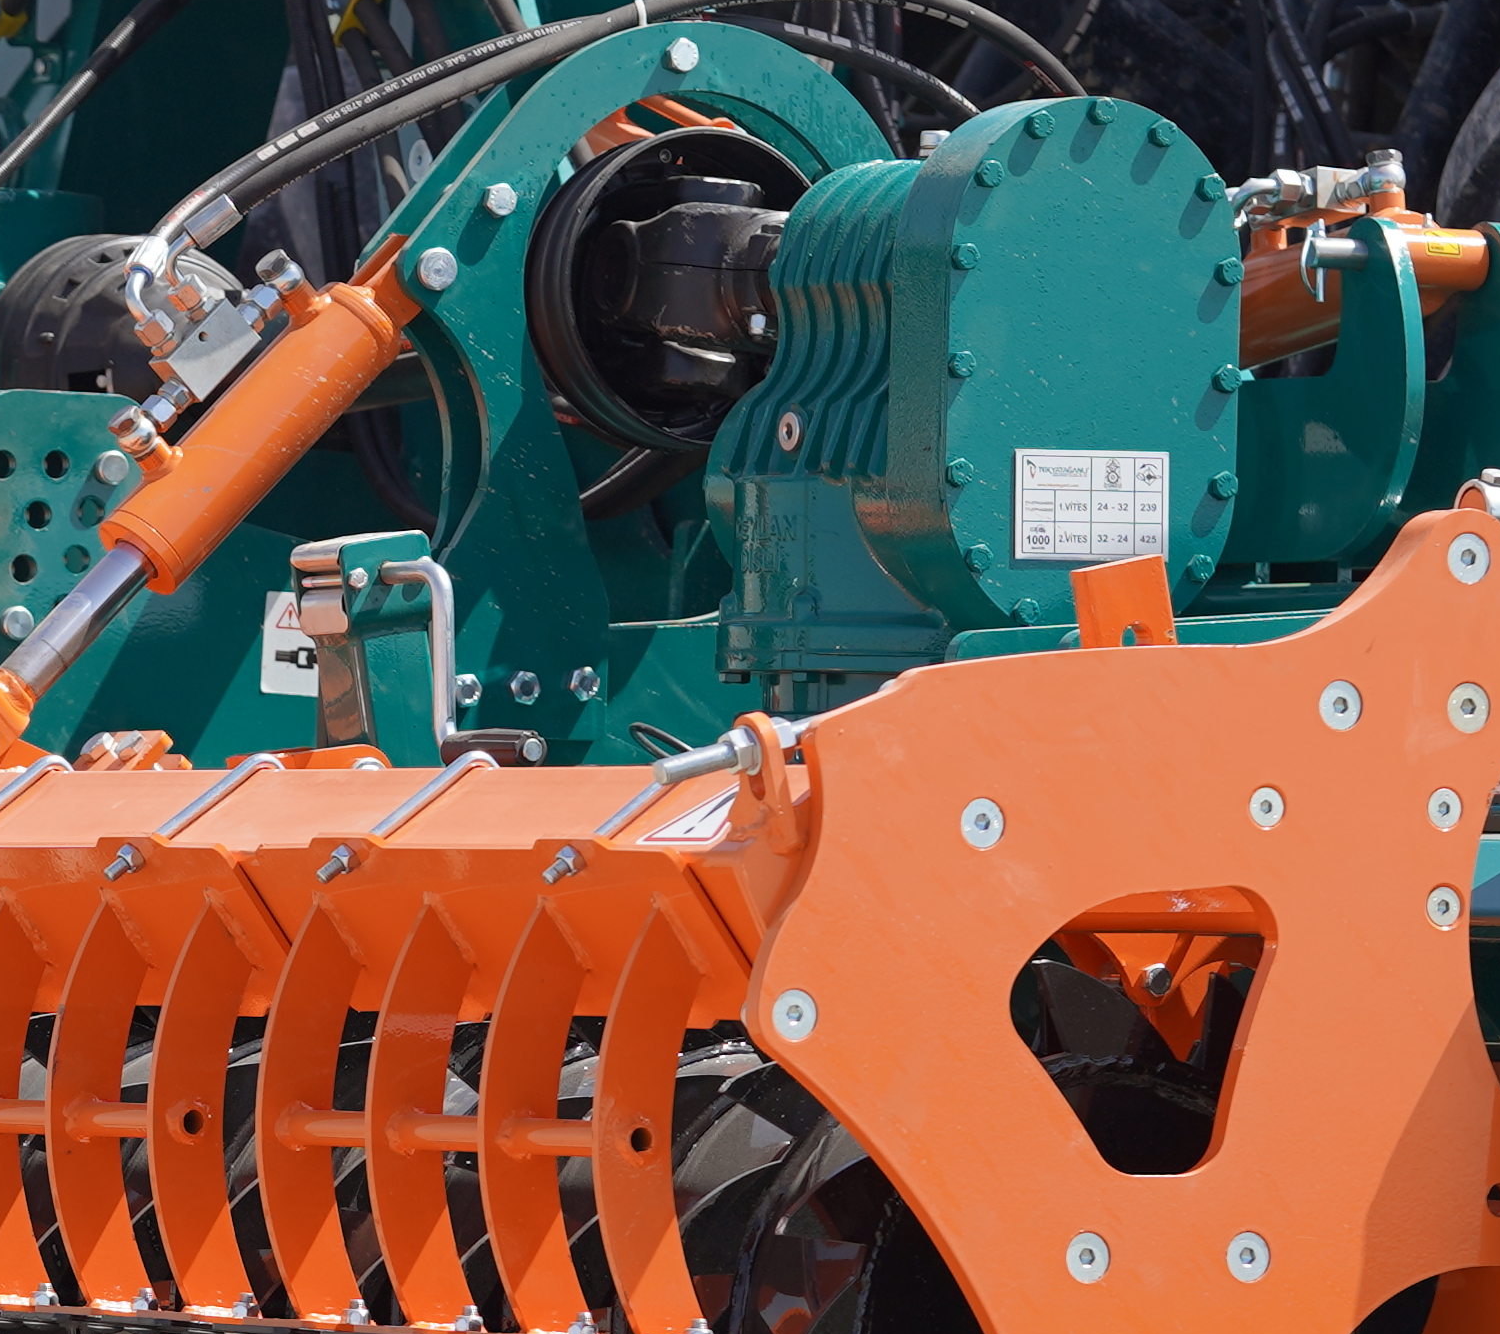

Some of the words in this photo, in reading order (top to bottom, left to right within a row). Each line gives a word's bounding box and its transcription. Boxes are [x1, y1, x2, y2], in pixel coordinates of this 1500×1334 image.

[497, 37, 516, 49] 330
[516, 33, 534, 44] WP
[473, 44, 496, 58] BAR
[444, 56, 467, 69] SAE
[426, 63, 444, 76] 100
[400, 72, 427, 87] R2AT
[364, 91, 381, 104] WP
[323, 112, 341, 124] PSI
[1097, 502, 1109, 511] 24
[1117, 502, 1129, 512] 32
[1026, 534, 1050, 545] 1000
[1097, 534, 1109, 543] 32
[1117, 534, 1129, 543] 24
[1140, 534, 1157, 544] 425
